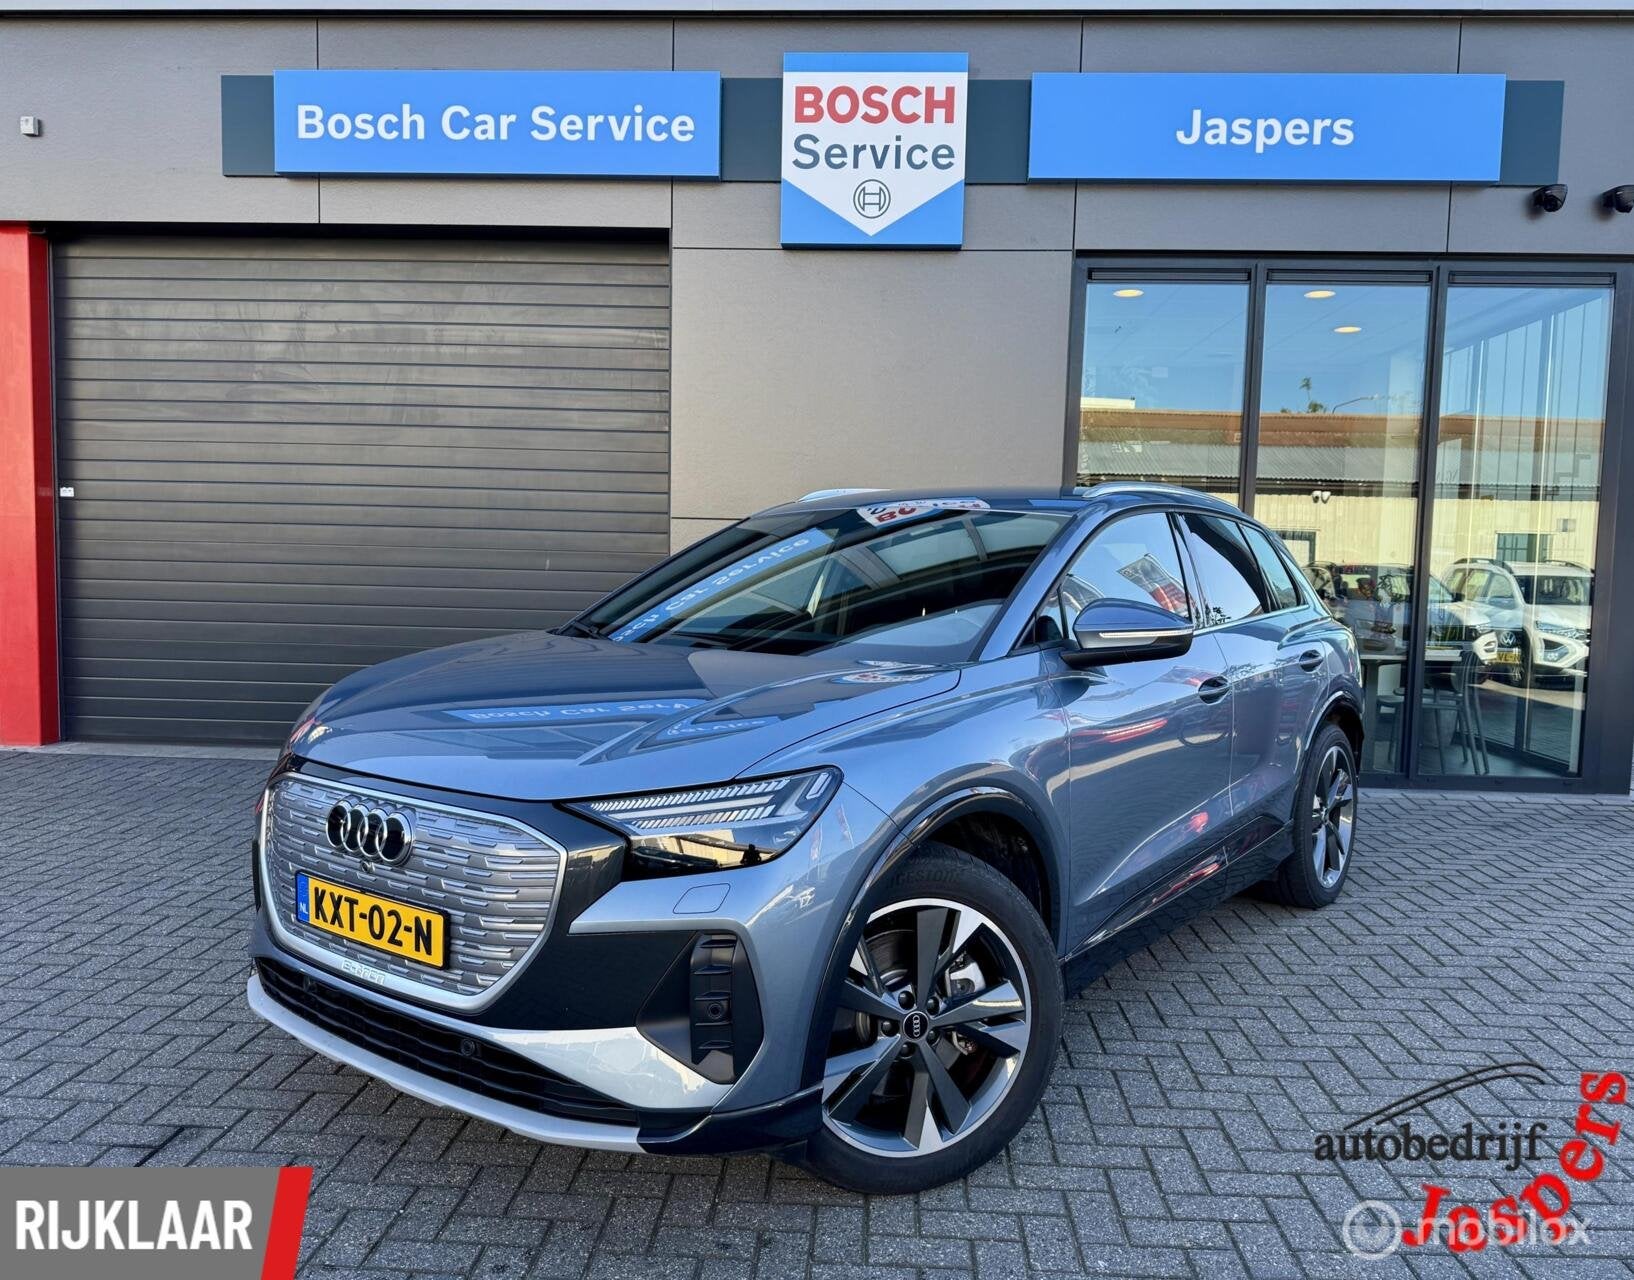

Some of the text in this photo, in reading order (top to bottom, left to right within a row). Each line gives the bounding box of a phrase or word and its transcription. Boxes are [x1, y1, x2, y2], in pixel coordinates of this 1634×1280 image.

[297, 103, 695, 142] Bosch Car Service
[794, 85, 955, 124] BOSCH
[1176, 109, 1354, 154] Jaspers
[792, 133, 955, 171] Service
[299, 901, 309, 914] NL
[313, 886, 433, 956] KXT-02-N
